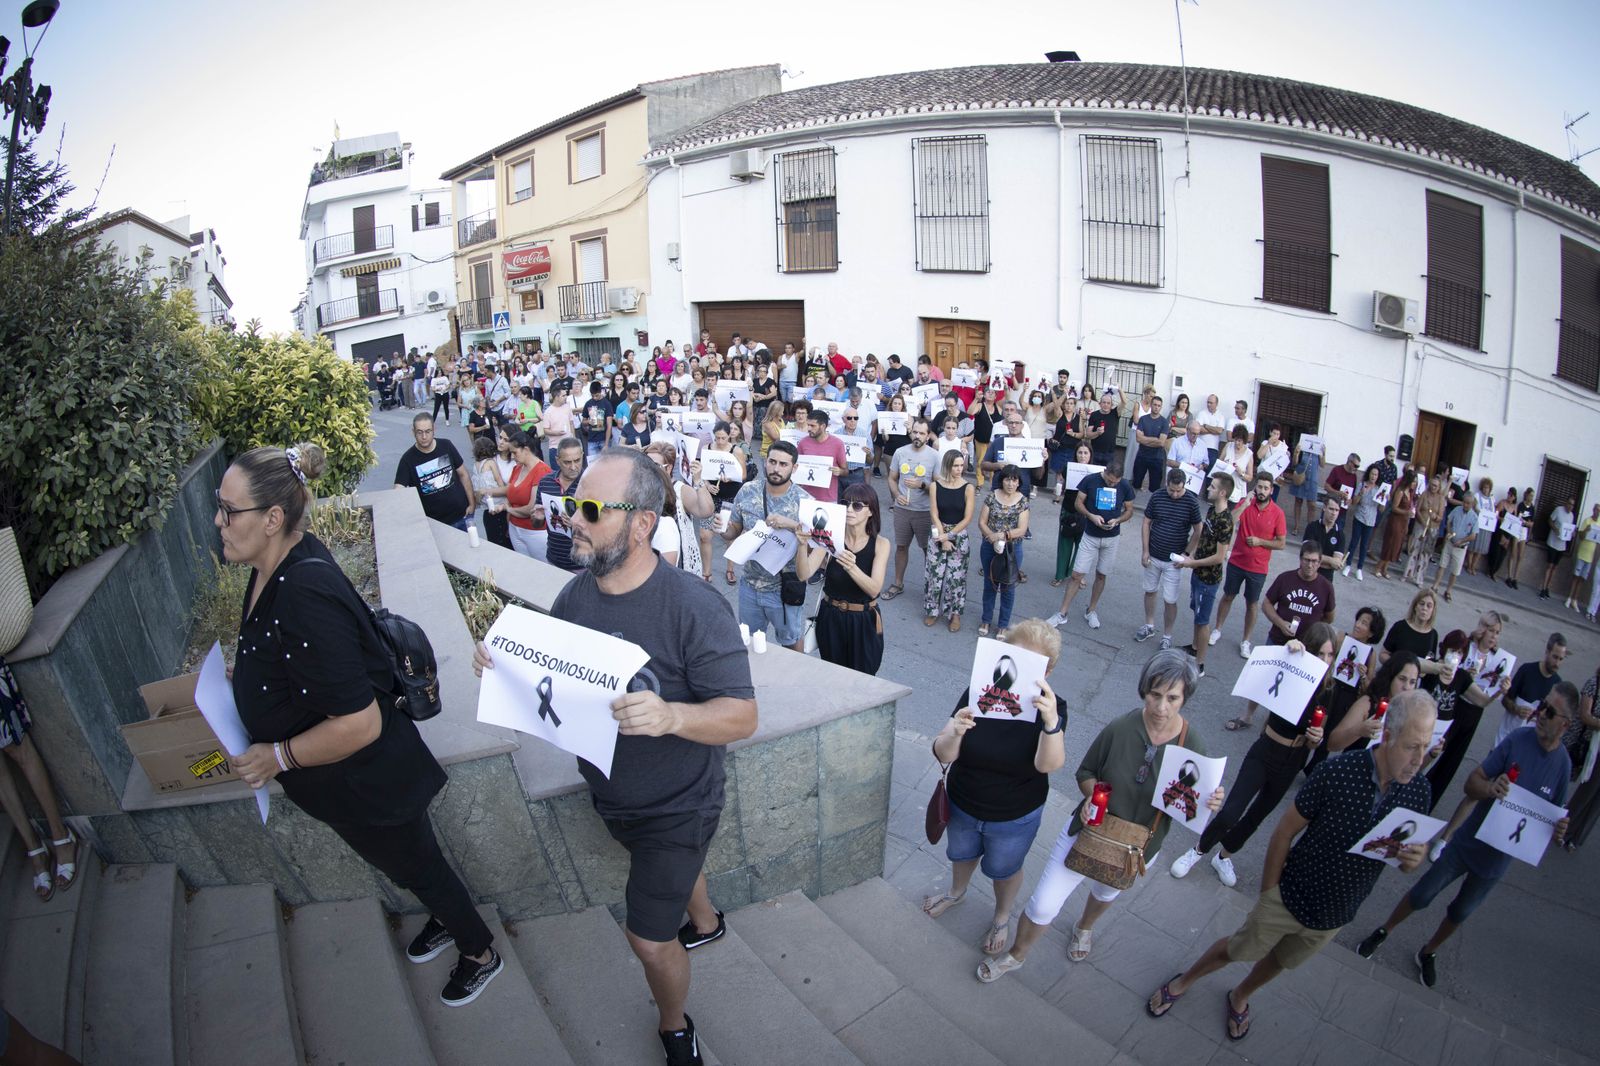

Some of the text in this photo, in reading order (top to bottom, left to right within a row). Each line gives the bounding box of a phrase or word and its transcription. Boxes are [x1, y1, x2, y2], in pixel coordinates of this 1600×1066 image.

[513, 251, 544, 267] Coca-Cola
[533, 273, 549, 281] ARCO
[1445, 401, 1454, 410] 10
[1286, 588, 1320, 607] PHOENIX
[1288, 602, 1313, 615] ARIZONA
[491, 635, 620, 691] #TODOSSOMOSJUAN
[1250, 659, 1317, 684] #TODOSSOMOSJUAN
[981, 684, 1020, 701] JUAN
[978, 703, 1020, 714] TODOS
[979, 695, 1021, 708] SOMOS
[1168, 779, 1200, 800] JUAN
